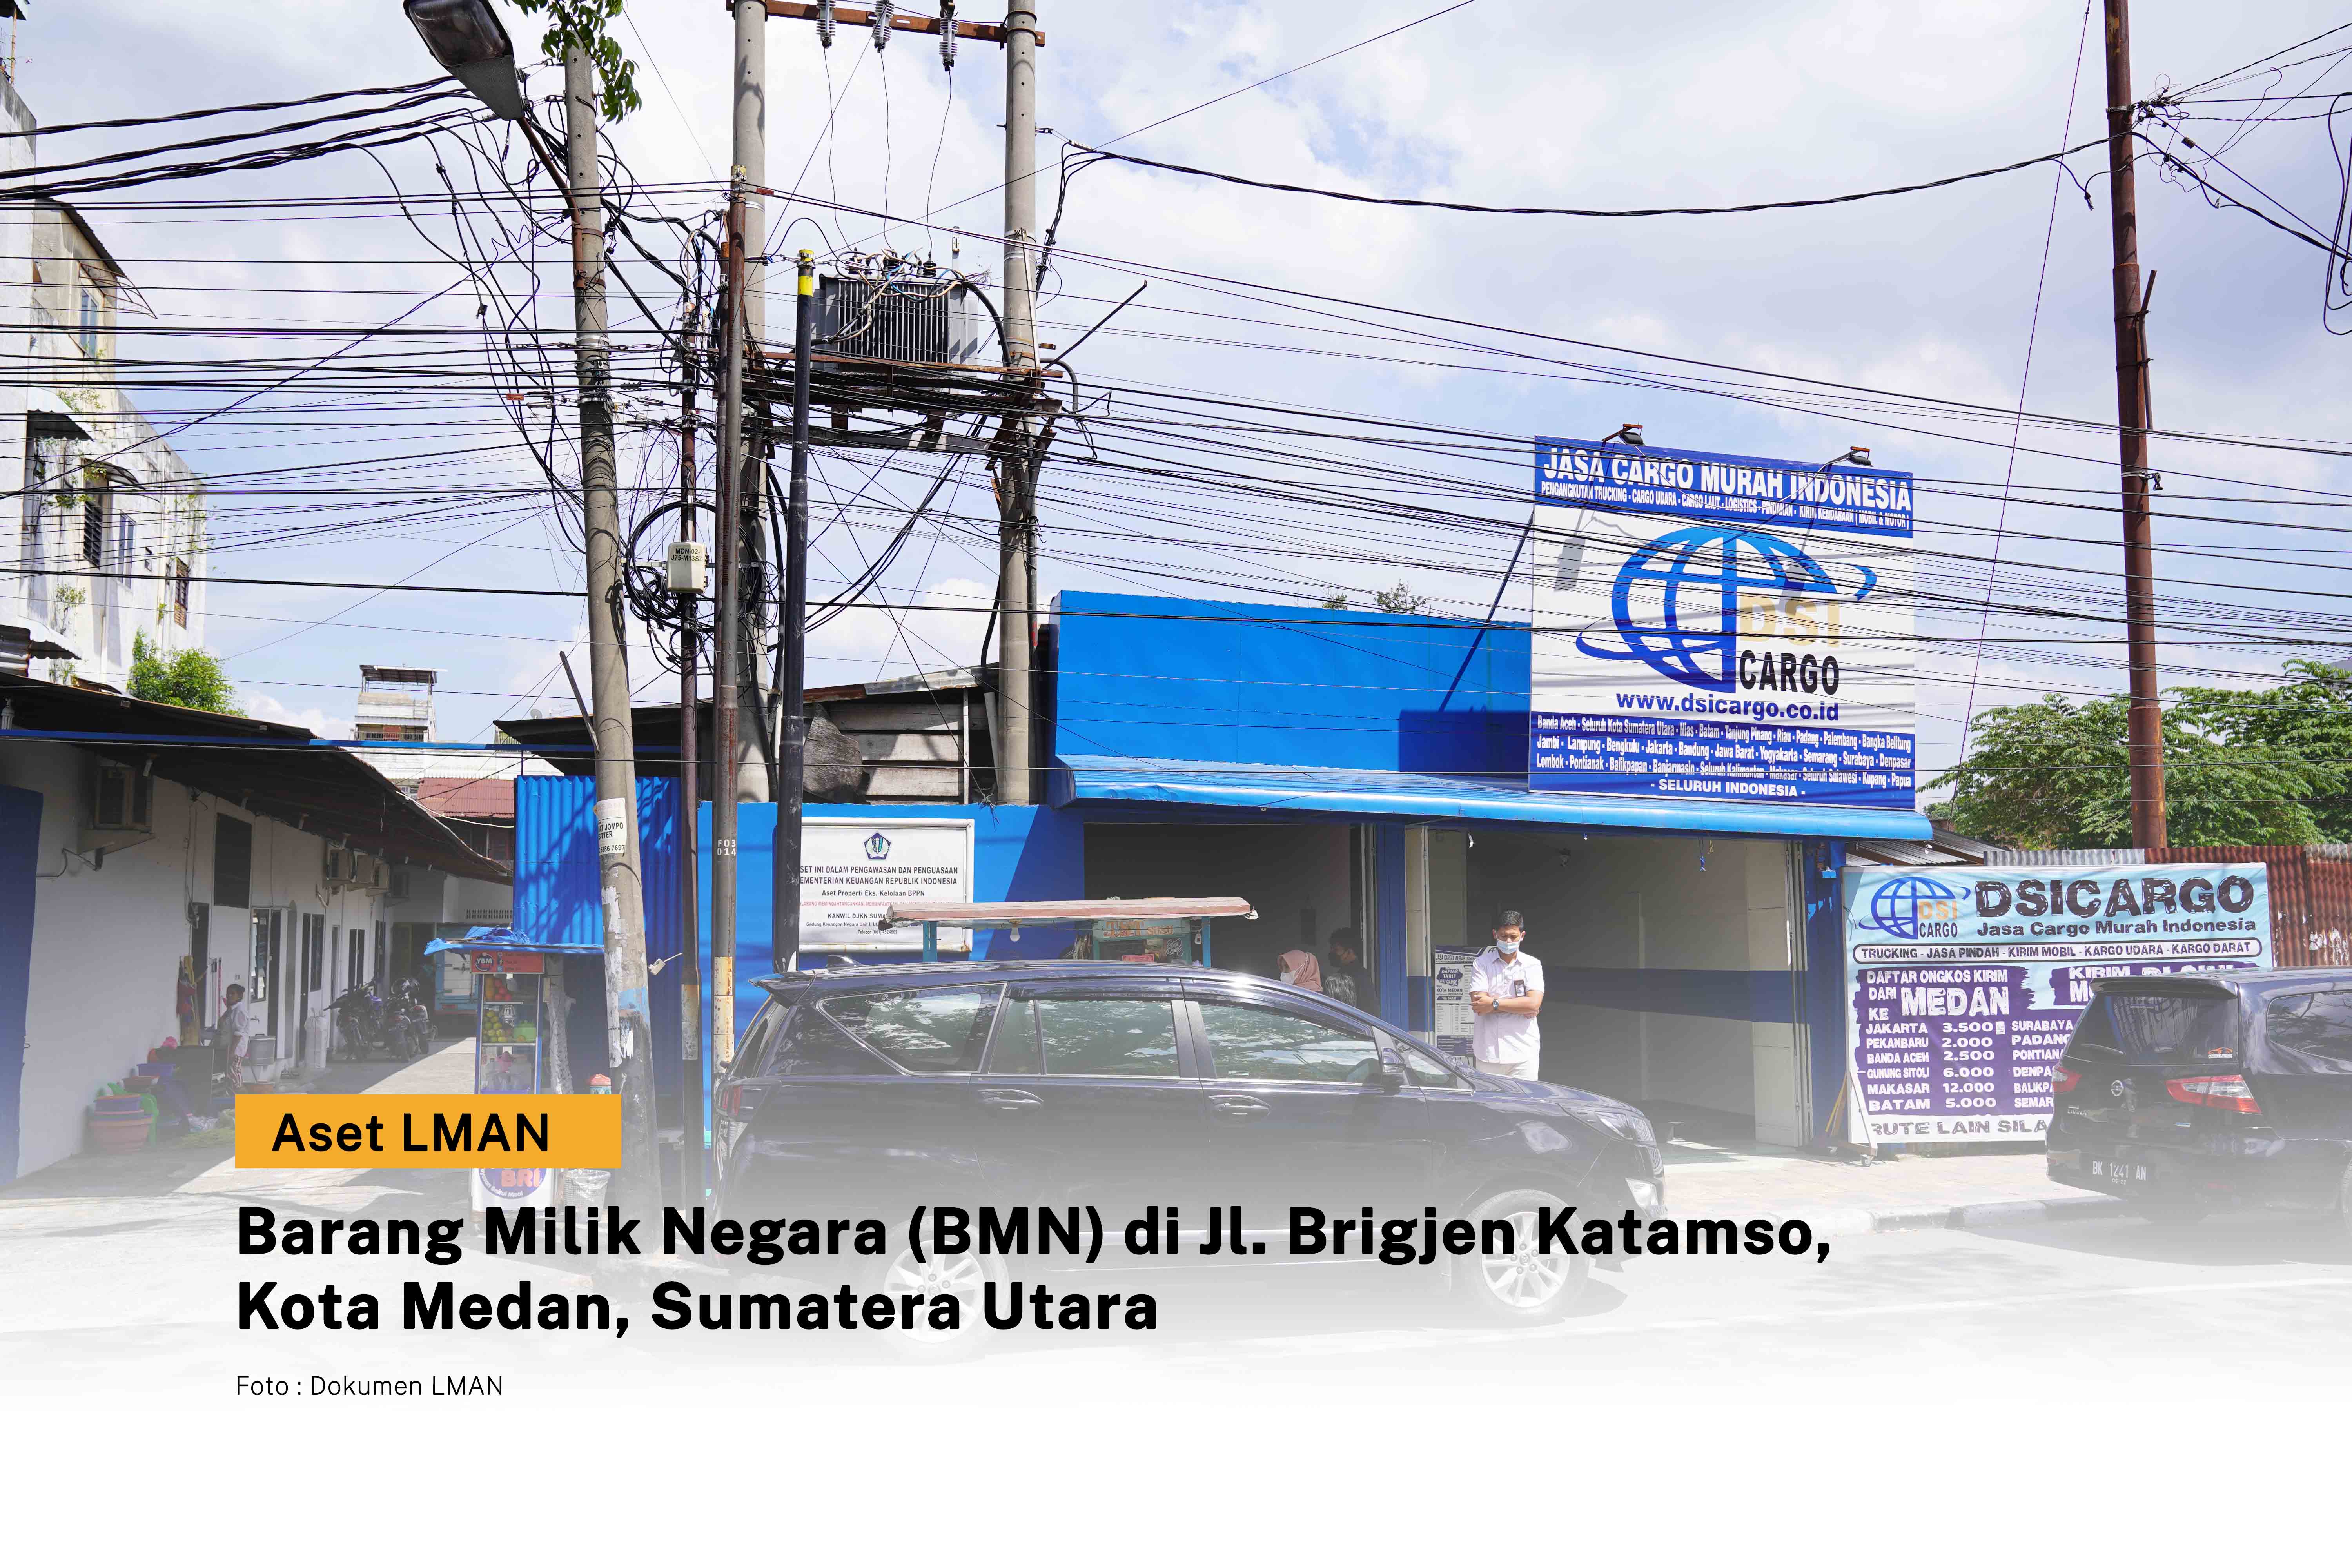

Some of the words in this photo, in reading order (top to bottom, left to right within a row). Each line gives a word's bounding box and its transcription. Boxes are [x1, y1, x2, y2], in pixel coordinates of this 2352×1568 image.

[1544, 448, 1605, 483] JASA
[1612, 454, 1693, 489] CARGO
[1701, 461, 1782, 499] MURAH
[1791, 472, 1912, 511] INDONESIA
[1541, 481, 1593, 499] PENGANGKUTAN
[1594, 485, 1627, 502] TRUCKING
[1632, 488, 1654, 505] CARGO
[1655, 491, 1677, 506] UDARA
[1682, 493, 1703, 509] CARGO
[1705, 495, 1721, 510] LAUT
[1725, 497, 1757, 514] LOGISTICS
[1762, 500, 1793, 517] PINDAHAN
[1799, 505, 1817, 519] KIRIM
[1818, 506, 1854, 523] KENDARAAN
[1740, 592, 1839, 648] DSI
[1739, 649, 1839, 695] CARGO
[1616, 693, 1839, 721] www.dsicargo.co.id
[1537, 715, 1558, 730] Banda
[1560, 716, 1576, 731] Aceh
[1581, 717, 1606, 732] Seluruh
[1608, 718, 1623, 733] Kota
[1624, 719, 1655, 735] Sumatera
[1657, 721, 1674, 736] Utara
[1679, 722, 1694, 737] Nias
[1699, 723, 1720, 739] Batam
[1725, 725, 1749, 744] Tanjung
[1751, 726, 1772, 745] Pinang
[1796, 729, 1819, 748] Padang
[1824, 731, 1857, 750] Palembang
[1862, 733, 1885, 751] Bangka
[1886, 735, 1911, 754] Belitung
[1537, 734, 1560, 749] Jambi
[1568, 736, 1601, 755] Lampung
[1606, 737, 1640, 756] Bengkulu
[1645, 739, 1673, 755] Jakarta
[1679, 741, 1710, 760] Bandung
[1715, 743, 1734, 758] Jawa
[1735, 744, 1755, 759] Barat
[1760, 745, 1798, 764] Yogyakarta
[1803, 748, 1838, 768] Semarang
[1843, 750, 1874, 769] Surabaya
[1879, 753, 1911, 771] Denpasar
[1537, 753, 1564, 768] Lombok
[1569, 754, 1604, 771] Pontianak
[1610, 756, 1648, 776] Balikpapan
[1653, 759, 1695, 778] Banjarmasin
[1700, 761, 1726, 777] Seluruh
[1727, 762, 1764, 779] Kalimantan
[1802, 767, 1828, 782] Seluruh
[1828, 768, 1857, 784] Sulawesi
[1862, 771, 1887, 789] Kupang
[1891, 772, 1911, 790] Papua
[1659, 779, 1722, 793] SELURUH
[1725, 782, 1798, 797] INDONESIA
[605, 822, 623, 831] JOMPO
[1918, 901, 1957, 920] DSI
[1975, 875, 2254, 918] DSICARGO
[1919, 922, 1957, 938] CARGO
[1977, 922, 2024, 936] Jasa
[2030, 921, 2090, 937] Cargo
[2096, 920, 2157, 934] Murah
[2163, 917, 2256, 932] Indonesia
[1861, 948, 1918, 958] TRUCKING
[1927, 947, 1956, 958] JASA
[1959, 947, 2000, 958] PINDAH
[2008, 947, 2038, 957] KIRIM
[2042, 946, 2076, 957] MOBIL
[2084, 946, 2123, 956] KARGO
[2126, 944, 2163, 956] UDARA
[2172, 943, 2210, 954] KARGO
[2212, 942, 2251, 953] DARAT
[1867, 971, 1918, 984] DAFTAR
[1920, 970, 1971, 983] ONGKOS
[1973, 969, 2008, 982] KIRIM
[2069, 966, 2131, 979] KIRIM
[1869, 987, 1897, 1001] DARI
[1900, 986, 2010, 1017] MEDAN
[1868, 1007, 1889, 1021] KE
[1866, 1023, 1928, 1034] JAKARTA
[1942, 1022, 1994, 1032] 3.500
[2011, 1020, 2073, 1031] SURABAYA
[1866, 1037, 1929, 1049] PEKANBARU
[1942, 1037, 1993, 1047] 2.000
[1867, 1053, 1901, 1064] BANDA
[1903, 1052, 1929, 1063] ACEH
[1943, 1050, 1995, 1061] 2.500
[1867, 1068, 1902, 1079] GUNUNG
[1903, 1067, 1930, 1078] SITOLI
[1943, 1067, 1994, 1077] 6.000
[1867, 1083, 1930, 1095] MAKASAR
[1942, 1082, 1994, 1093] 12.000
[1869, 1099, 1931, 1111] BATAM
[1945, 1098, 1996, 1108] 5.000
[1937, 1121, 1991, 1134] LAIN
[501, 1168, 540, 1188] BRI
[2092, 1160, 2103, 1176] BK
[2110, 1162, 2129, 1179] 1241
[2136, 1165, 2146, 1181] AN
